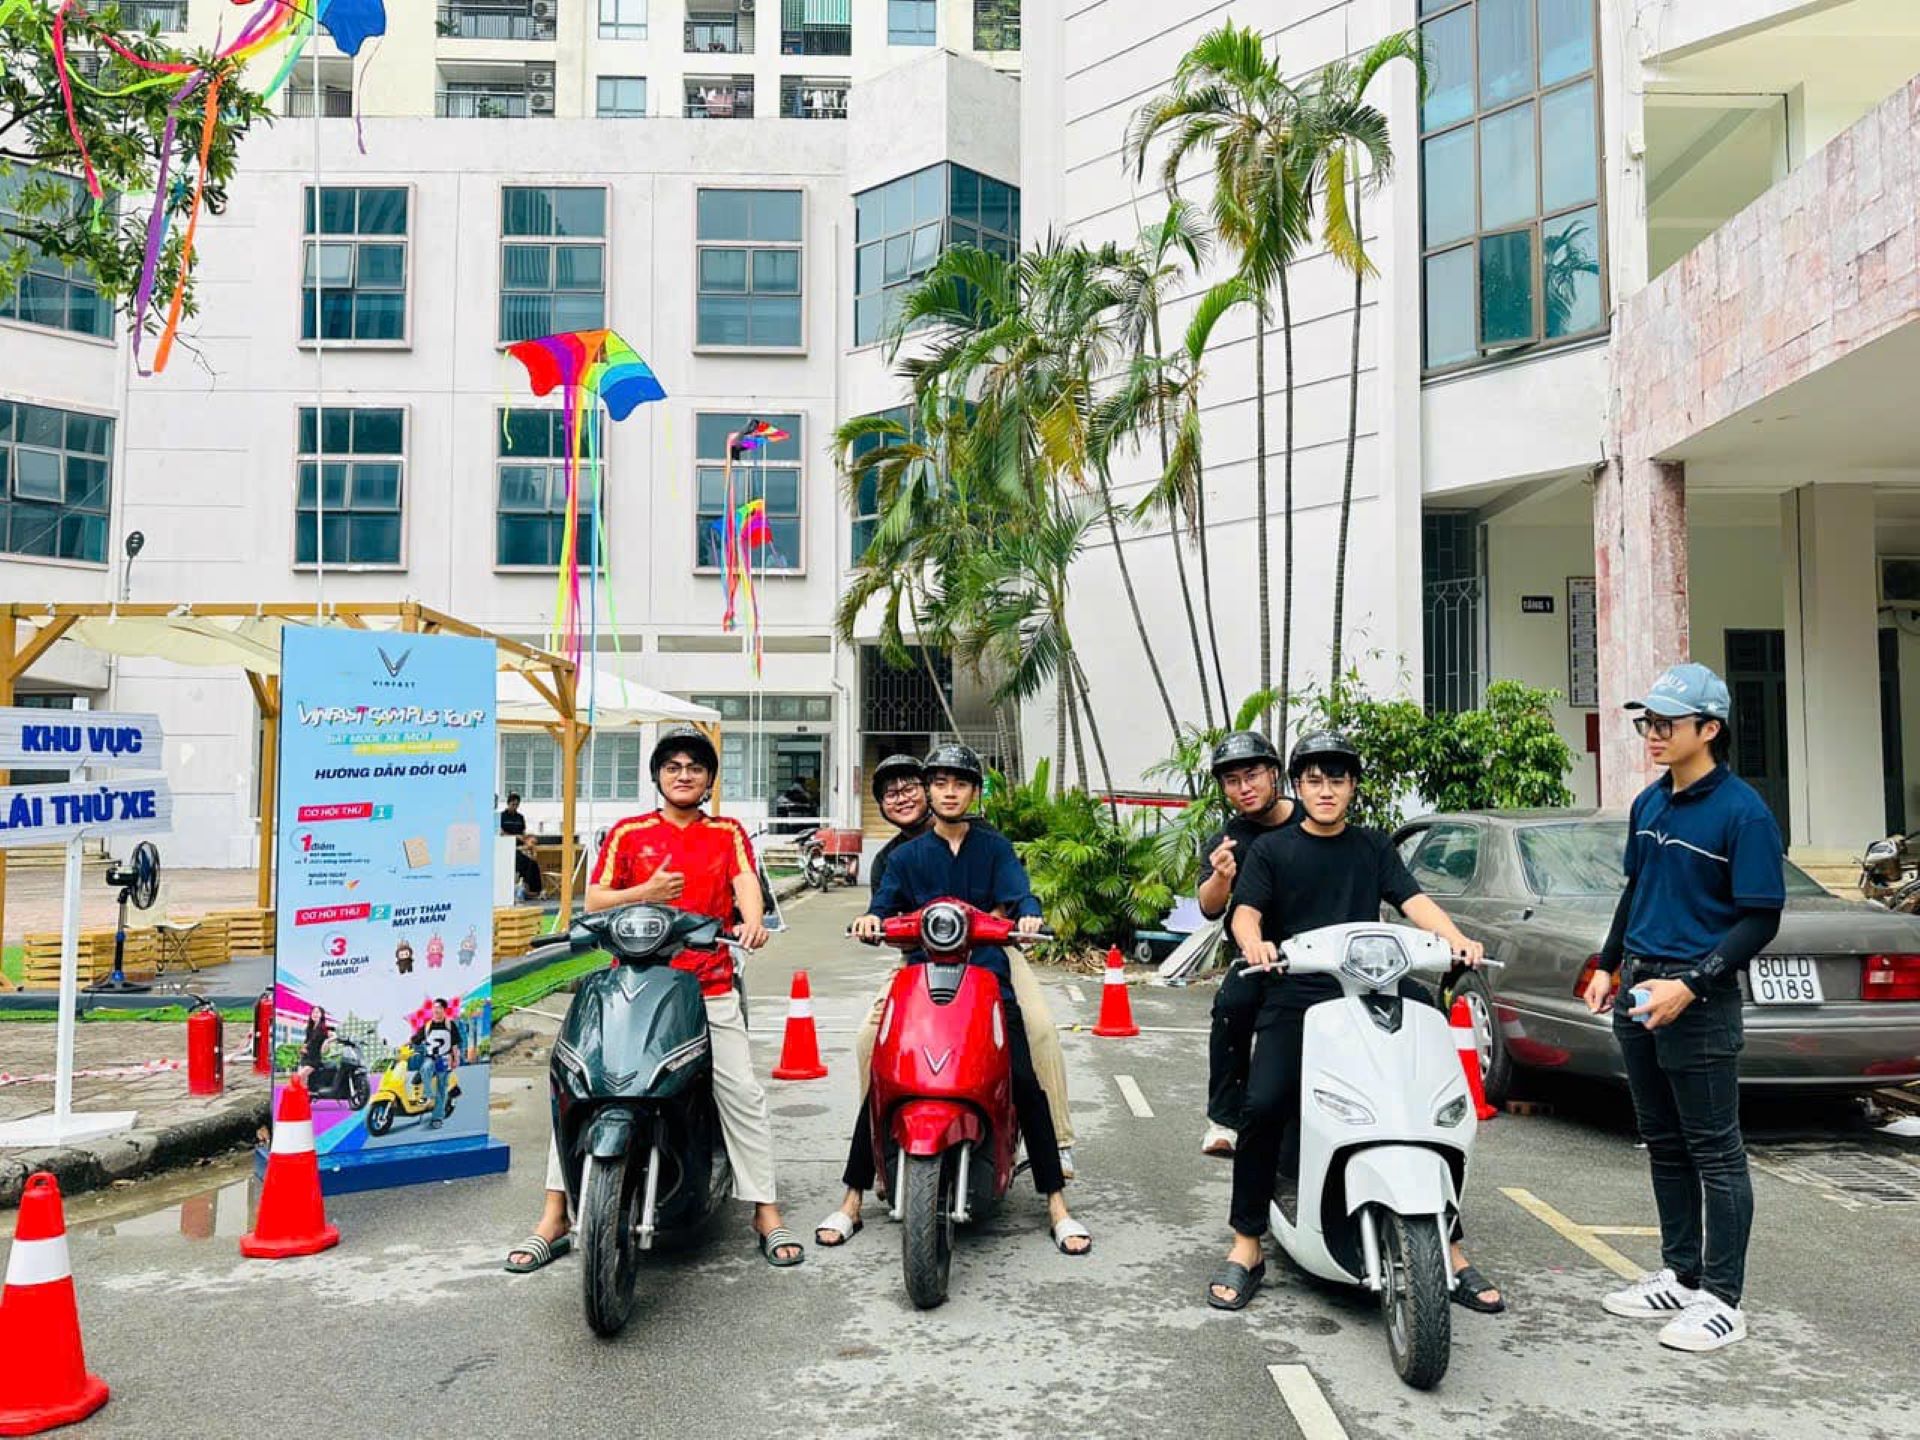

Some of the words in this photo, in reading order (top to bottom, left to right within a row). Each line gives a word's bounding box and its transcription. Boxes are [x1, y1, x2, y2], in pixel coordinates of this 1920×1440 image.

[442, 708, 486, 728] TOUR
[21, 724, 82, 752] KHU
[88, 726, 143, 757] VỰC
[50, 786, 120, 824] THỬ
[120, 790, 156, 820] XE
[377, 806, 385, 818] 1
[300, 834, 313, 852] 1
[375, 906, 385, 919] 2
[392, 916, 418, 927] MAY
[330, 936, 347, 957] 3
[1758, 956, 1811, 978] 80LD
[1761, 979, 1814, 1000] 0189
